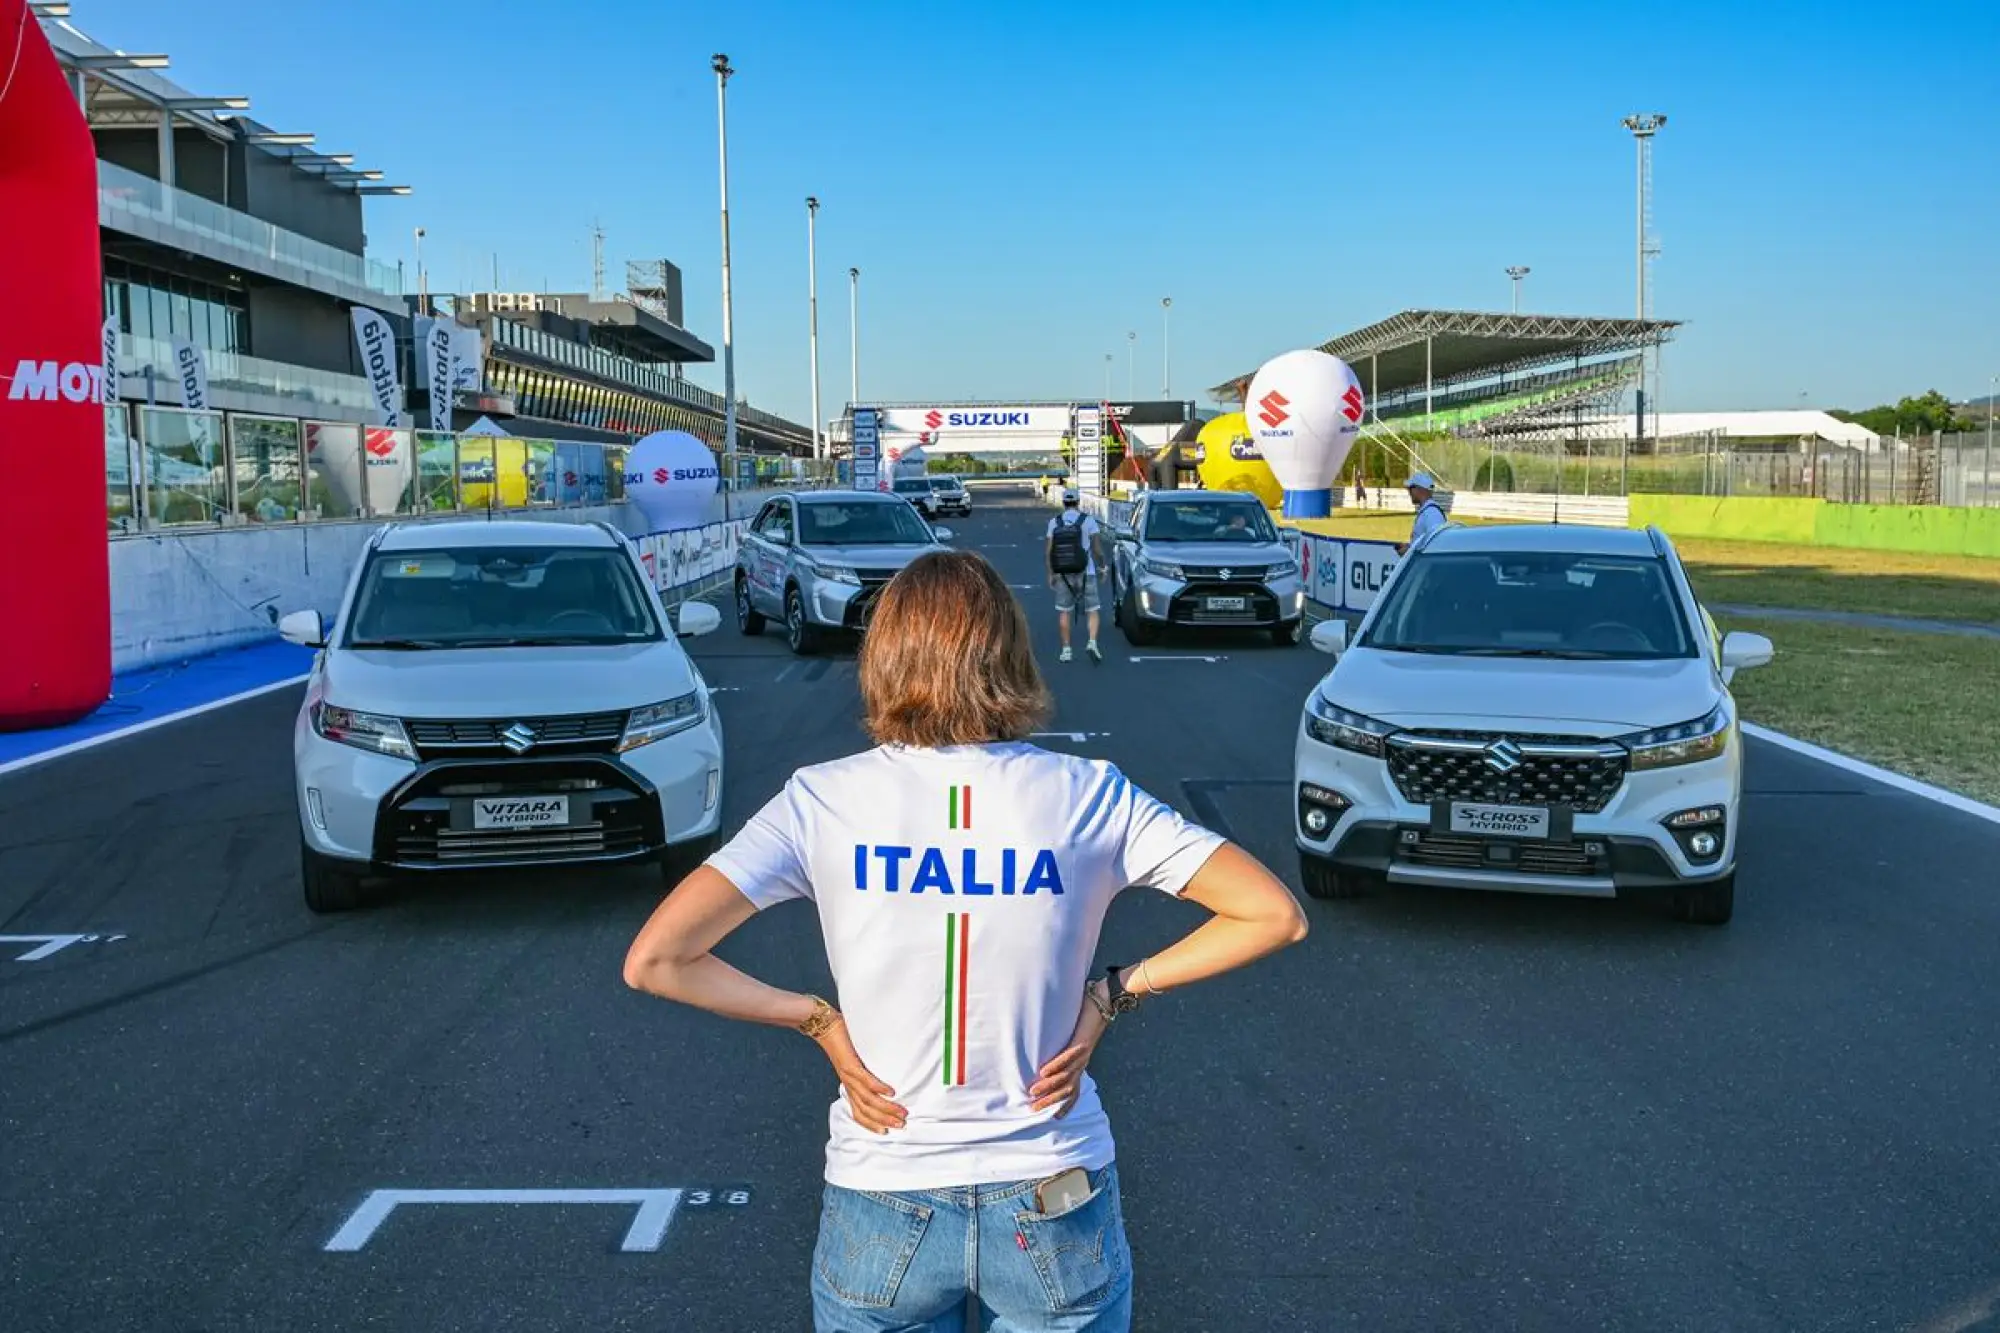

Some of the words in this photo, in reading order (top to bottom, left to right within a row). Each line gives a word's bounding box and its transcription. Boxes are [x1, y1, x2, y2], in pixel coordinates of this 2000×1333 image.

[432, 329, 450, 415] vittoria
[949, 412, 1029, 426] SUZUKI
[482, 801, 561, 814] VITARA
[493, 812, 551, 822] HYBRID
[1470, 820, 1528, 831] HYBRID
[854, 844, 1065, 896] ITALIA
